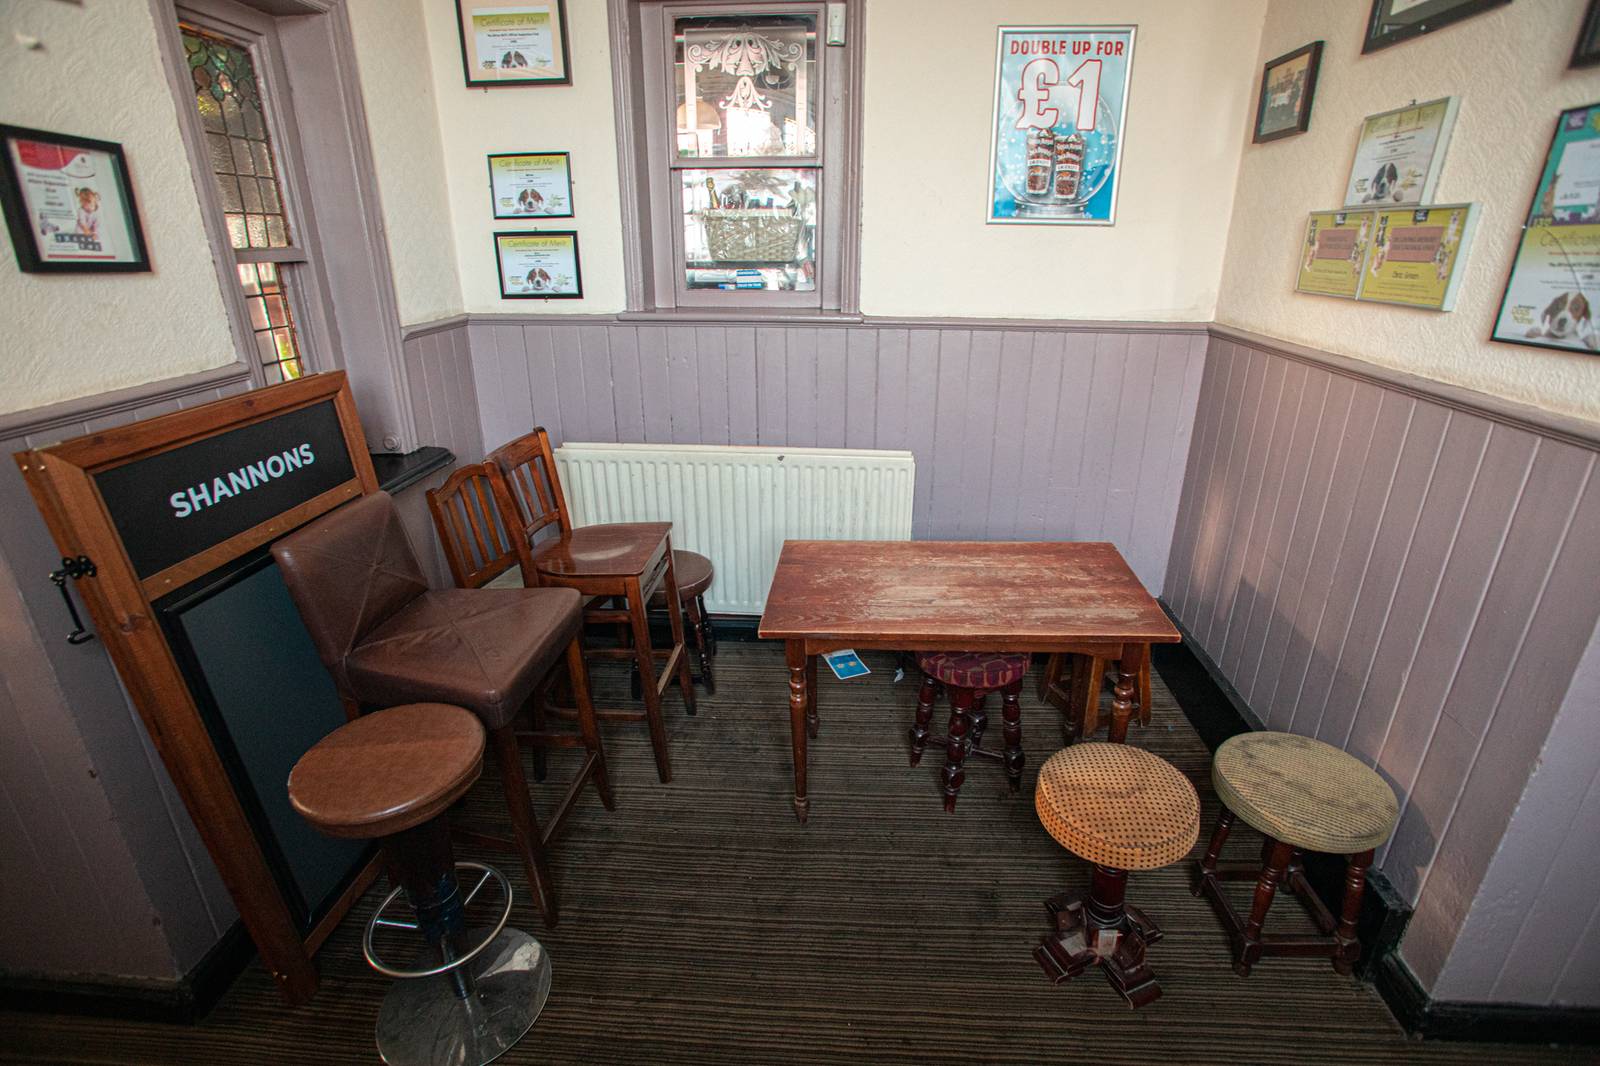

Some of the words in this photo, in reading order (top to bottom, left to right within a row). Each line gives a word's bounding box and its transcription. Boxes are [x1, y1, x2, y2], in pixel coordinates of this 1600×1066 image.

[480, 17, 515, 26] Certificate
[526, 15, 545, 25] Merit
[1010, 40, 1067, 55] DOUBLE
[1072, 41, 1091, 55] UP
[1096, 41, 1124, 56] FOR
[1015, 58, 1103, 131] £1
[508, 239, 539, 248] Certificate
[549, 239, 567, 247] Merit
[169, 443, 316, 519] SHANNONS
